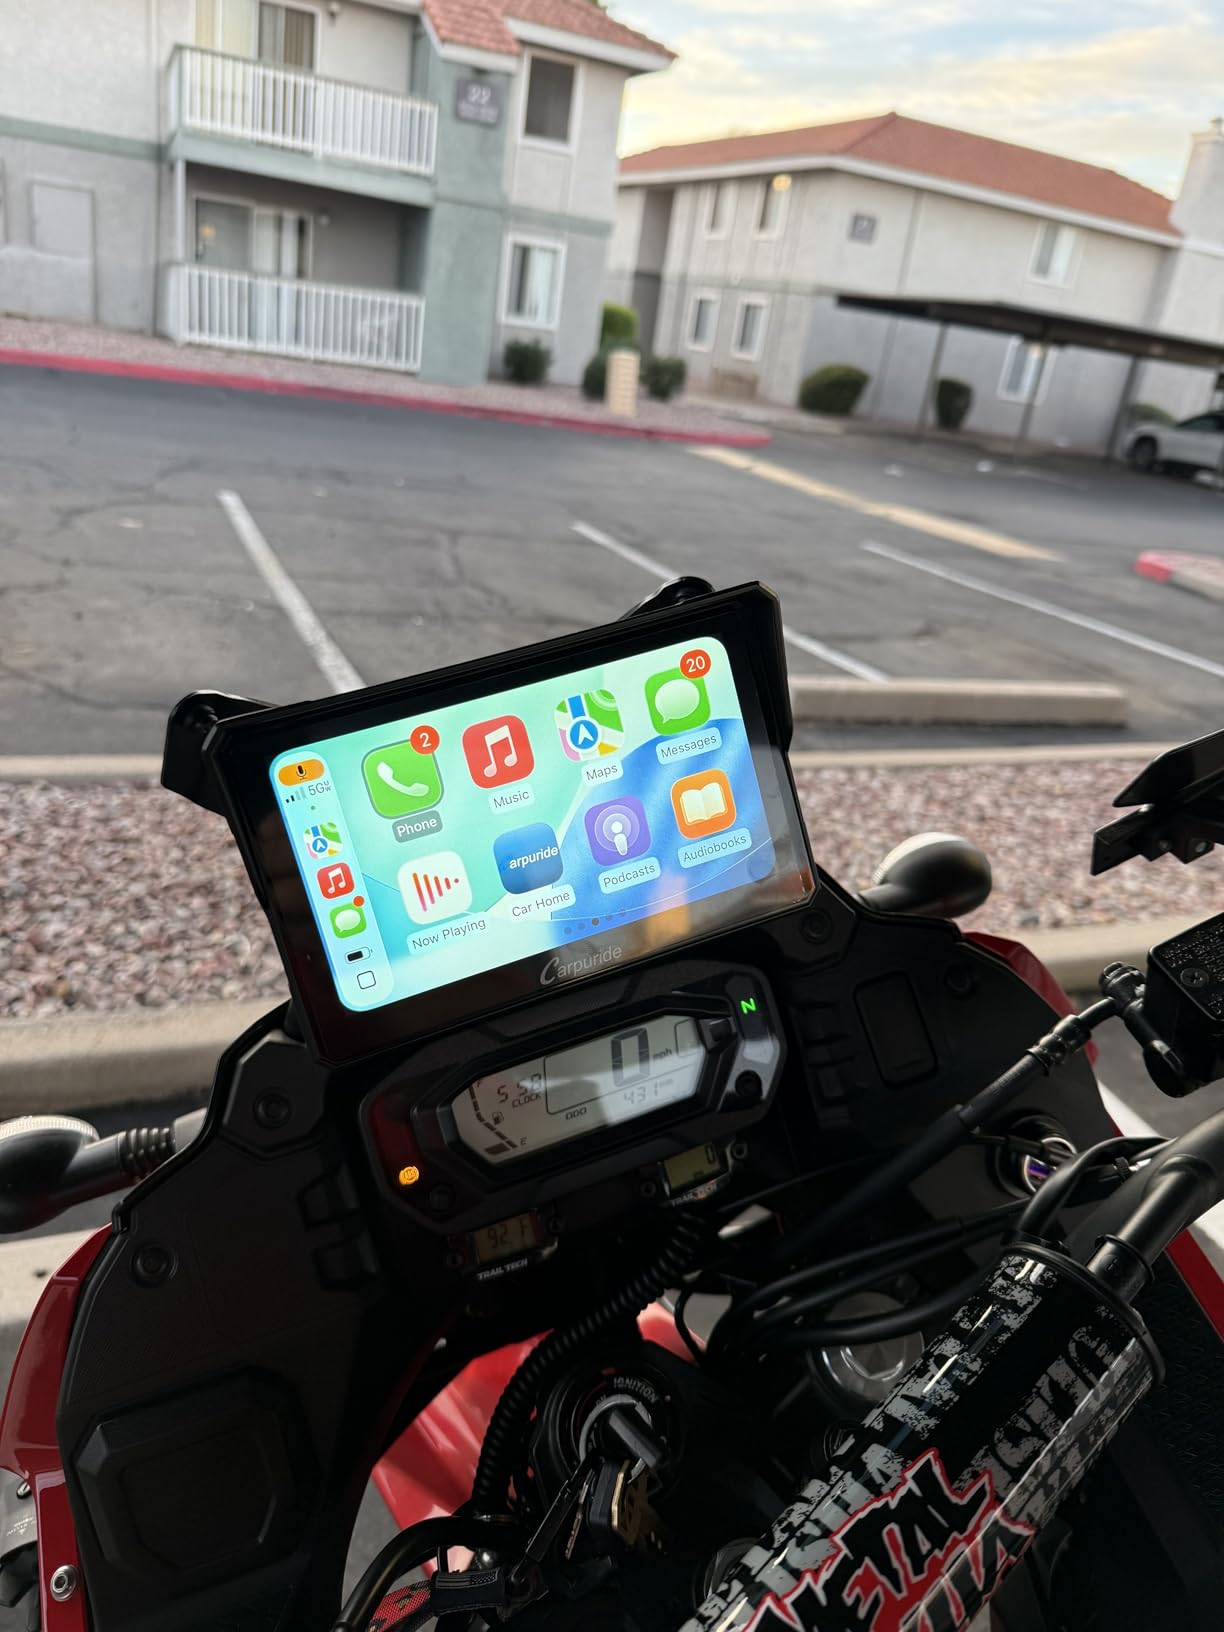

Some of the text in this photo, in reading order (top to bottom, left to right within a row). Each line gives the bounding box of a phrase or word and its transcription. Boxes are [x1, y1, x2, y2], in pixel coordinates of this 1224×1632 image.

[685, 655, 706, 673] 20
[419, 732, 432, 748] 2
[660, 734, 718, 759] Messages
[585, 762, 619, 782] Maps
[492, 789, 530, 809] Music
[396, 816, 438, 838] Phone
[508, 845, 560, 870] arpuride
[682, 833, 748, 863] Audiobooks
[602, 863, 656, 888] Podcasts
[511, 890, 571, 918] Car Home
[411, 917, 487, 951] Now Playing
[539, 943, 624, 986] Carpuride
[739, 997, 758, 1015] N
[610, 1027, 651, 1088] 0
[511, 1092, 543, 1108] CLOCK
[476, 1256, 528, 1281] TRAIL TECH
[613, 1376, 660, 1404] IGNITION
